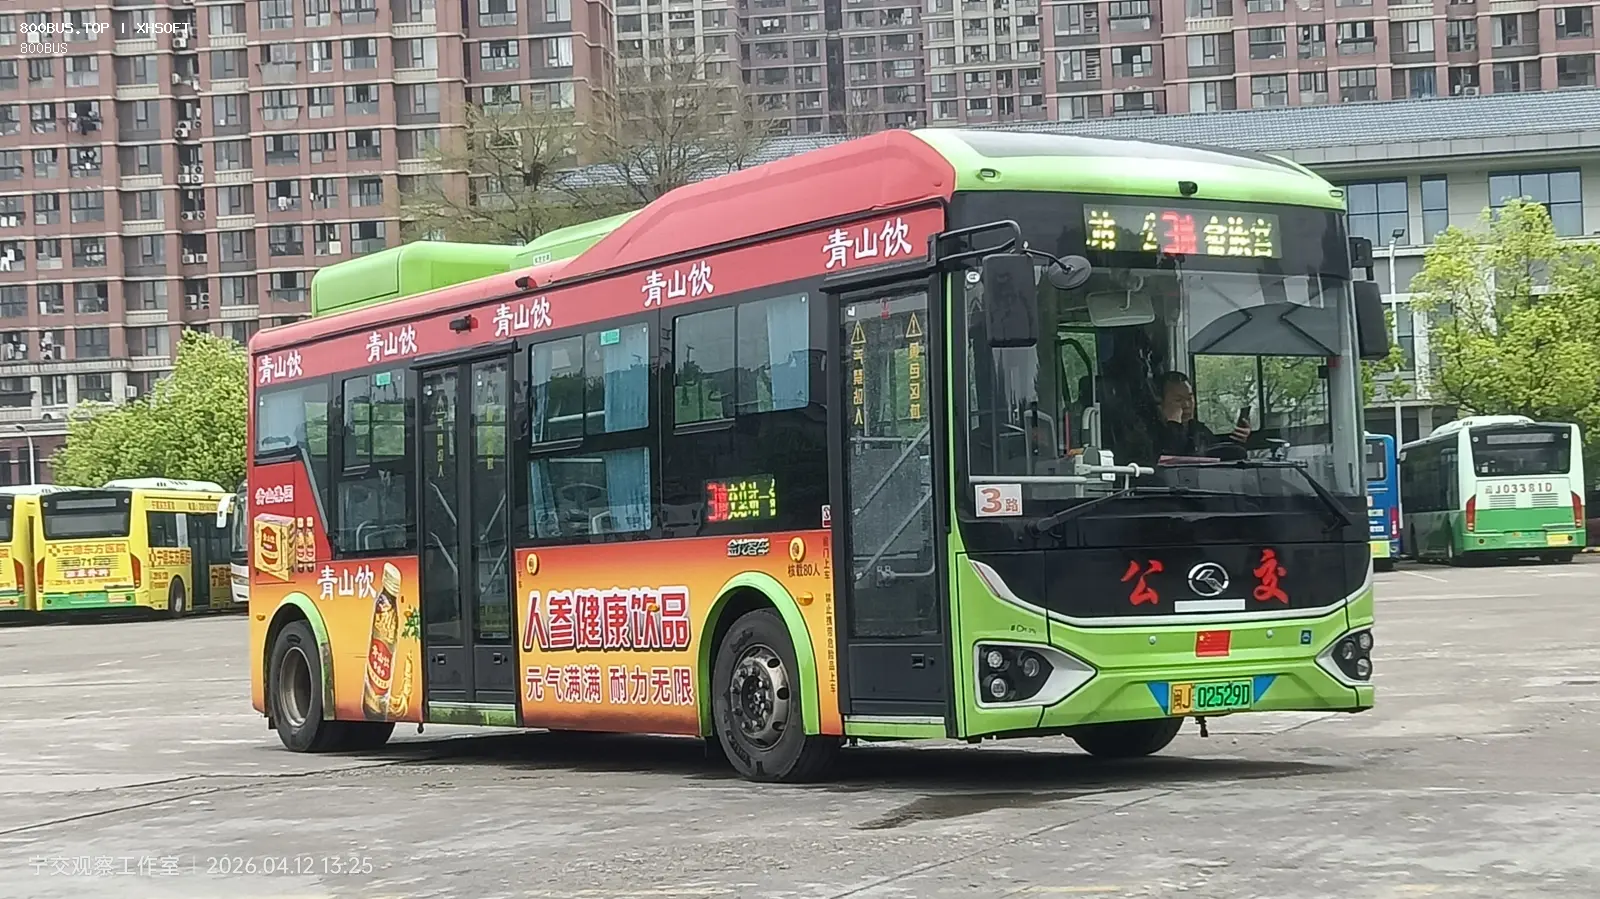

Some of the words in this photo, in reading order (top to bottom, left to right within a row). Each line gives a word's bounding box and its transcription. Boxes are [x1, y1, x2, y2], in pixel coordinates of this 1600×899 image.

[823, 218, 912, 268] 青山饮
[641, 261, 715, 307] 青山饮
[492, 296, 552, 337] 青山饮
[366, 324, 417, 362] 青山饮
[259, 350, 303, 384] 青山饮
[981, 488, 1018, 513] 3路
[317, 564, 378, 600] 青山饮
[1121, 560, 1163, 606] 公
[1253, 549, 1289, 604] 交
[523, 586, 691, 652] 人参健康饮品
[525, 664, 602, 701] 元气满满
[608, 664, 694, 705] 耐力无限
